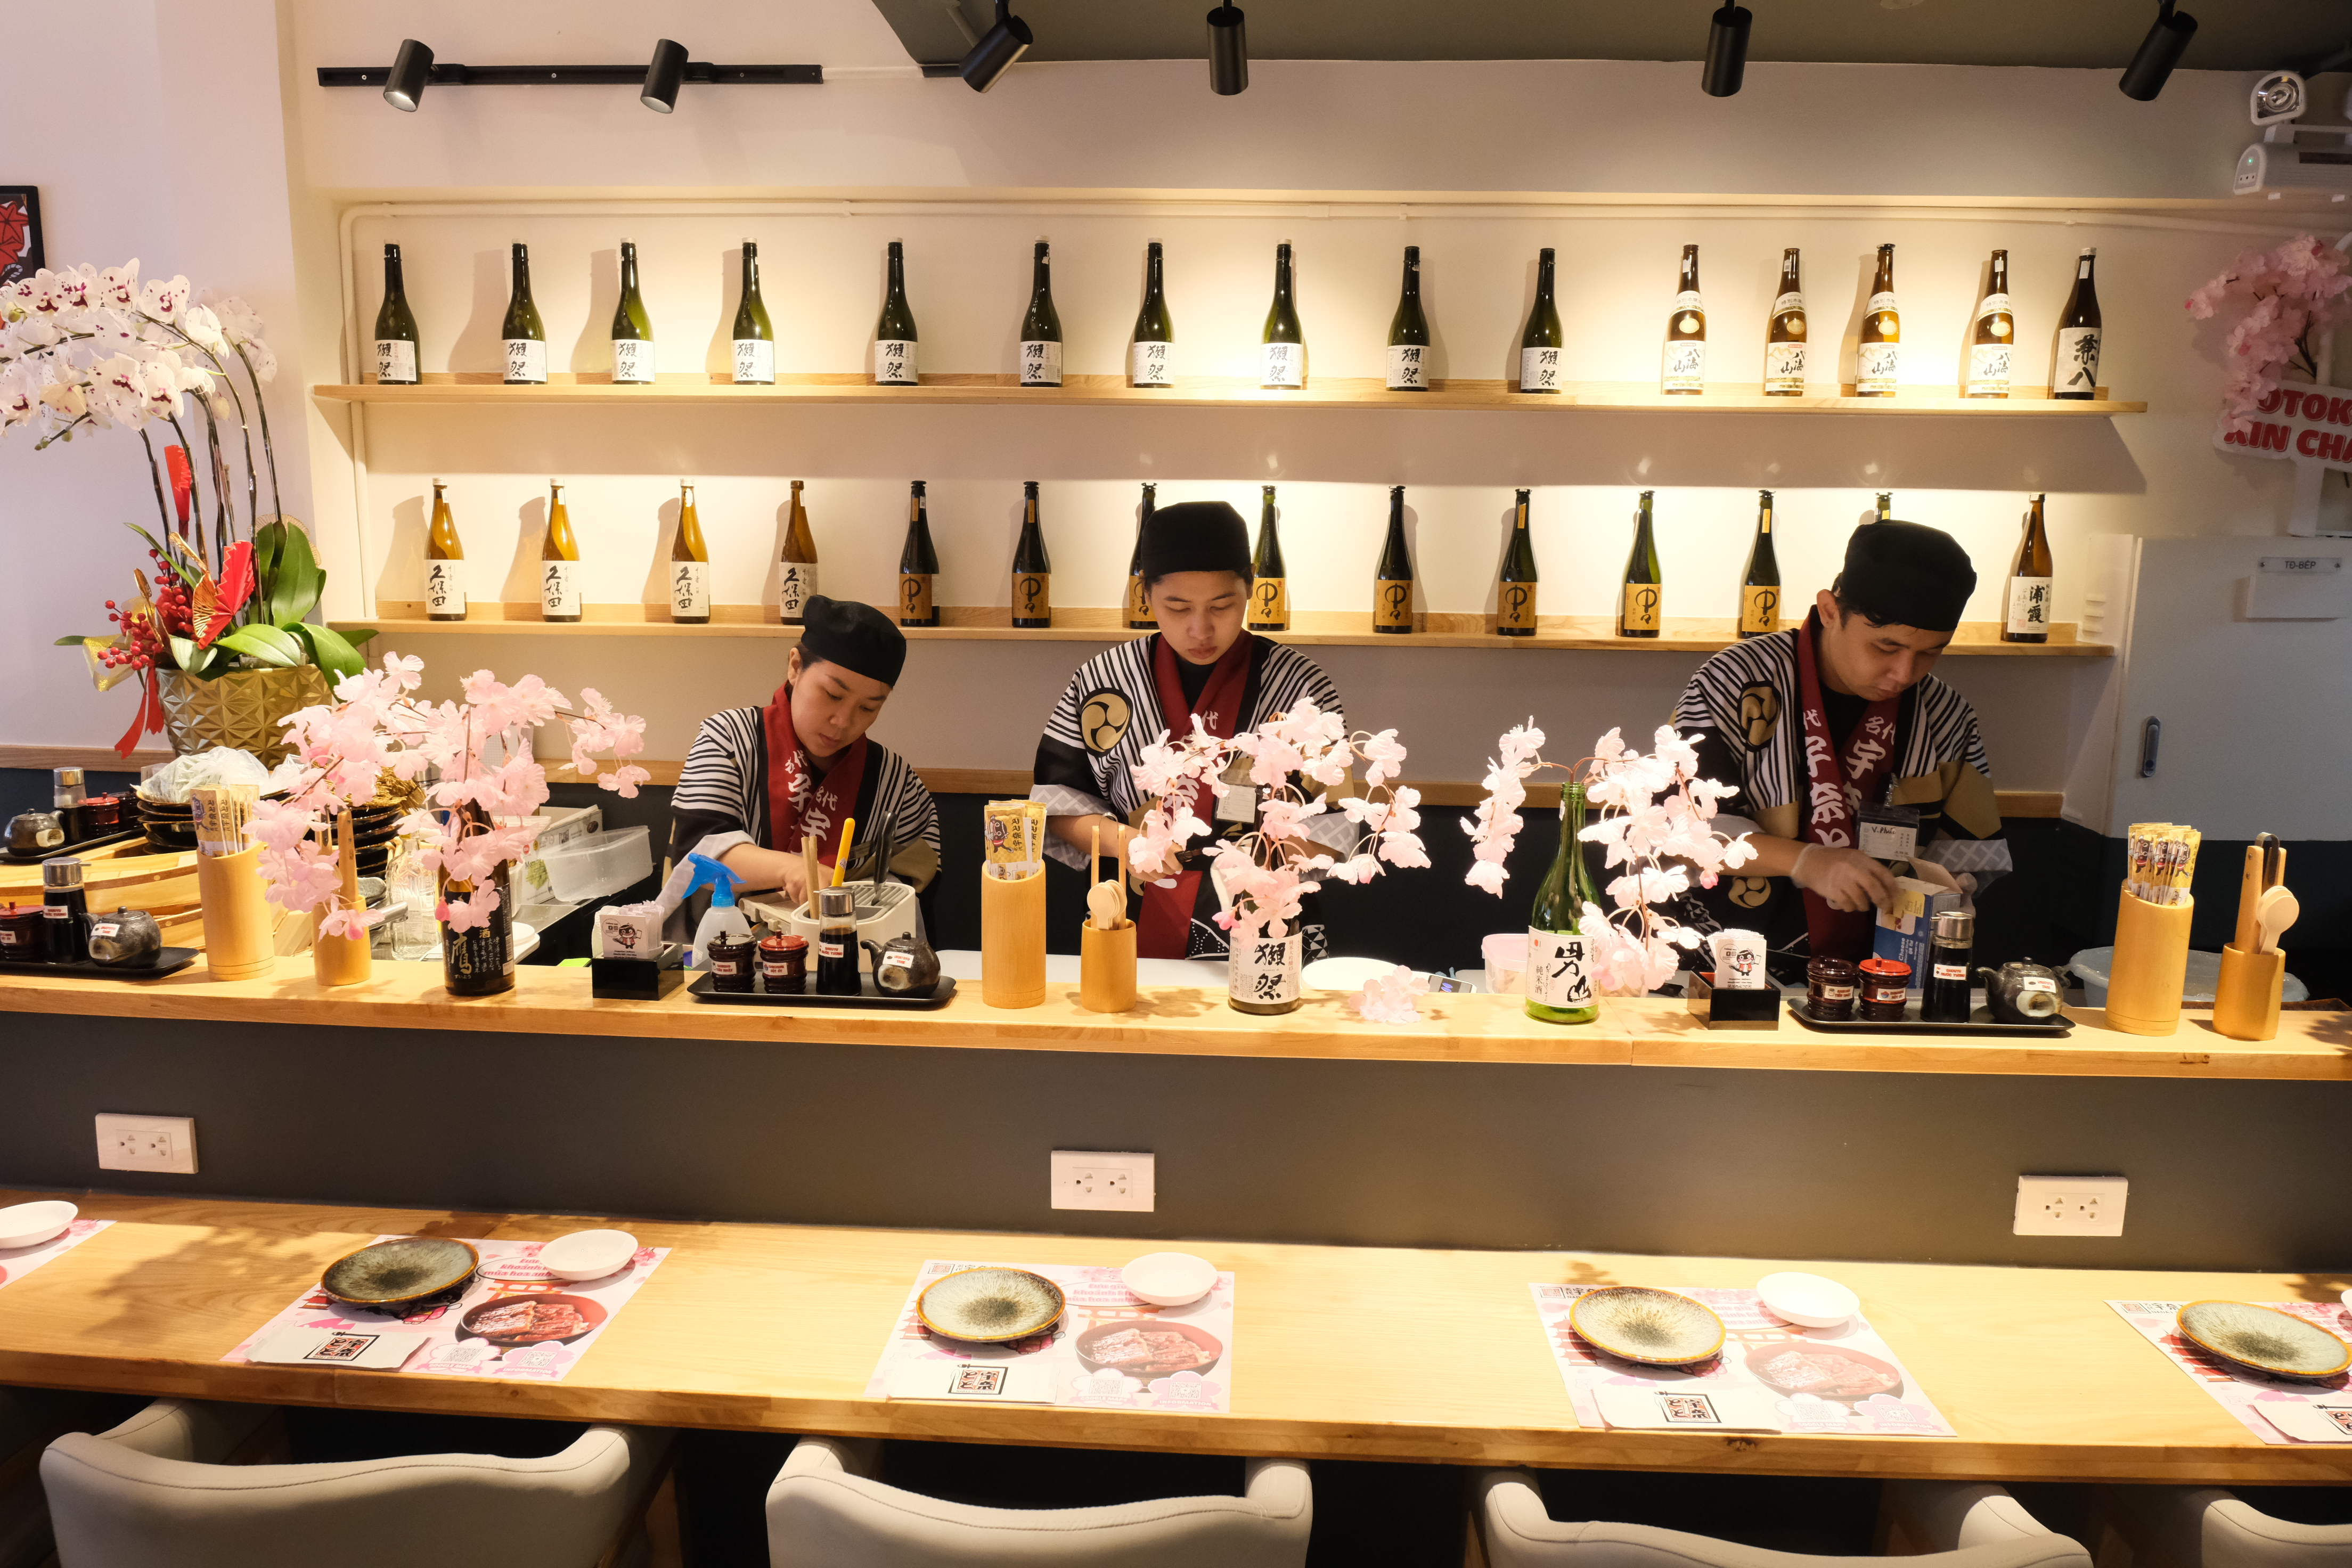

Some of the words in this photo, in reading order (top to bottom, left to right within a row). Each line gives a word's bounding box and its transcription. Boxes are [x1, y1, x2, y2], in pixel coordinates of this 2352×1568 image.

[2067, 334, 2097, 388] 兼八
[428, 564, 446, 607] 久保田
[544, 565, 562, 608] 久保田
[675, 566, 693, 609] 久保田
[782, 567, 800, 610] 久保田
[2027, 585, 2045, 623] 浦霞
[479, 928, 490, 938] 酒
[1253, 942, 1286, 1001] 獺祭
